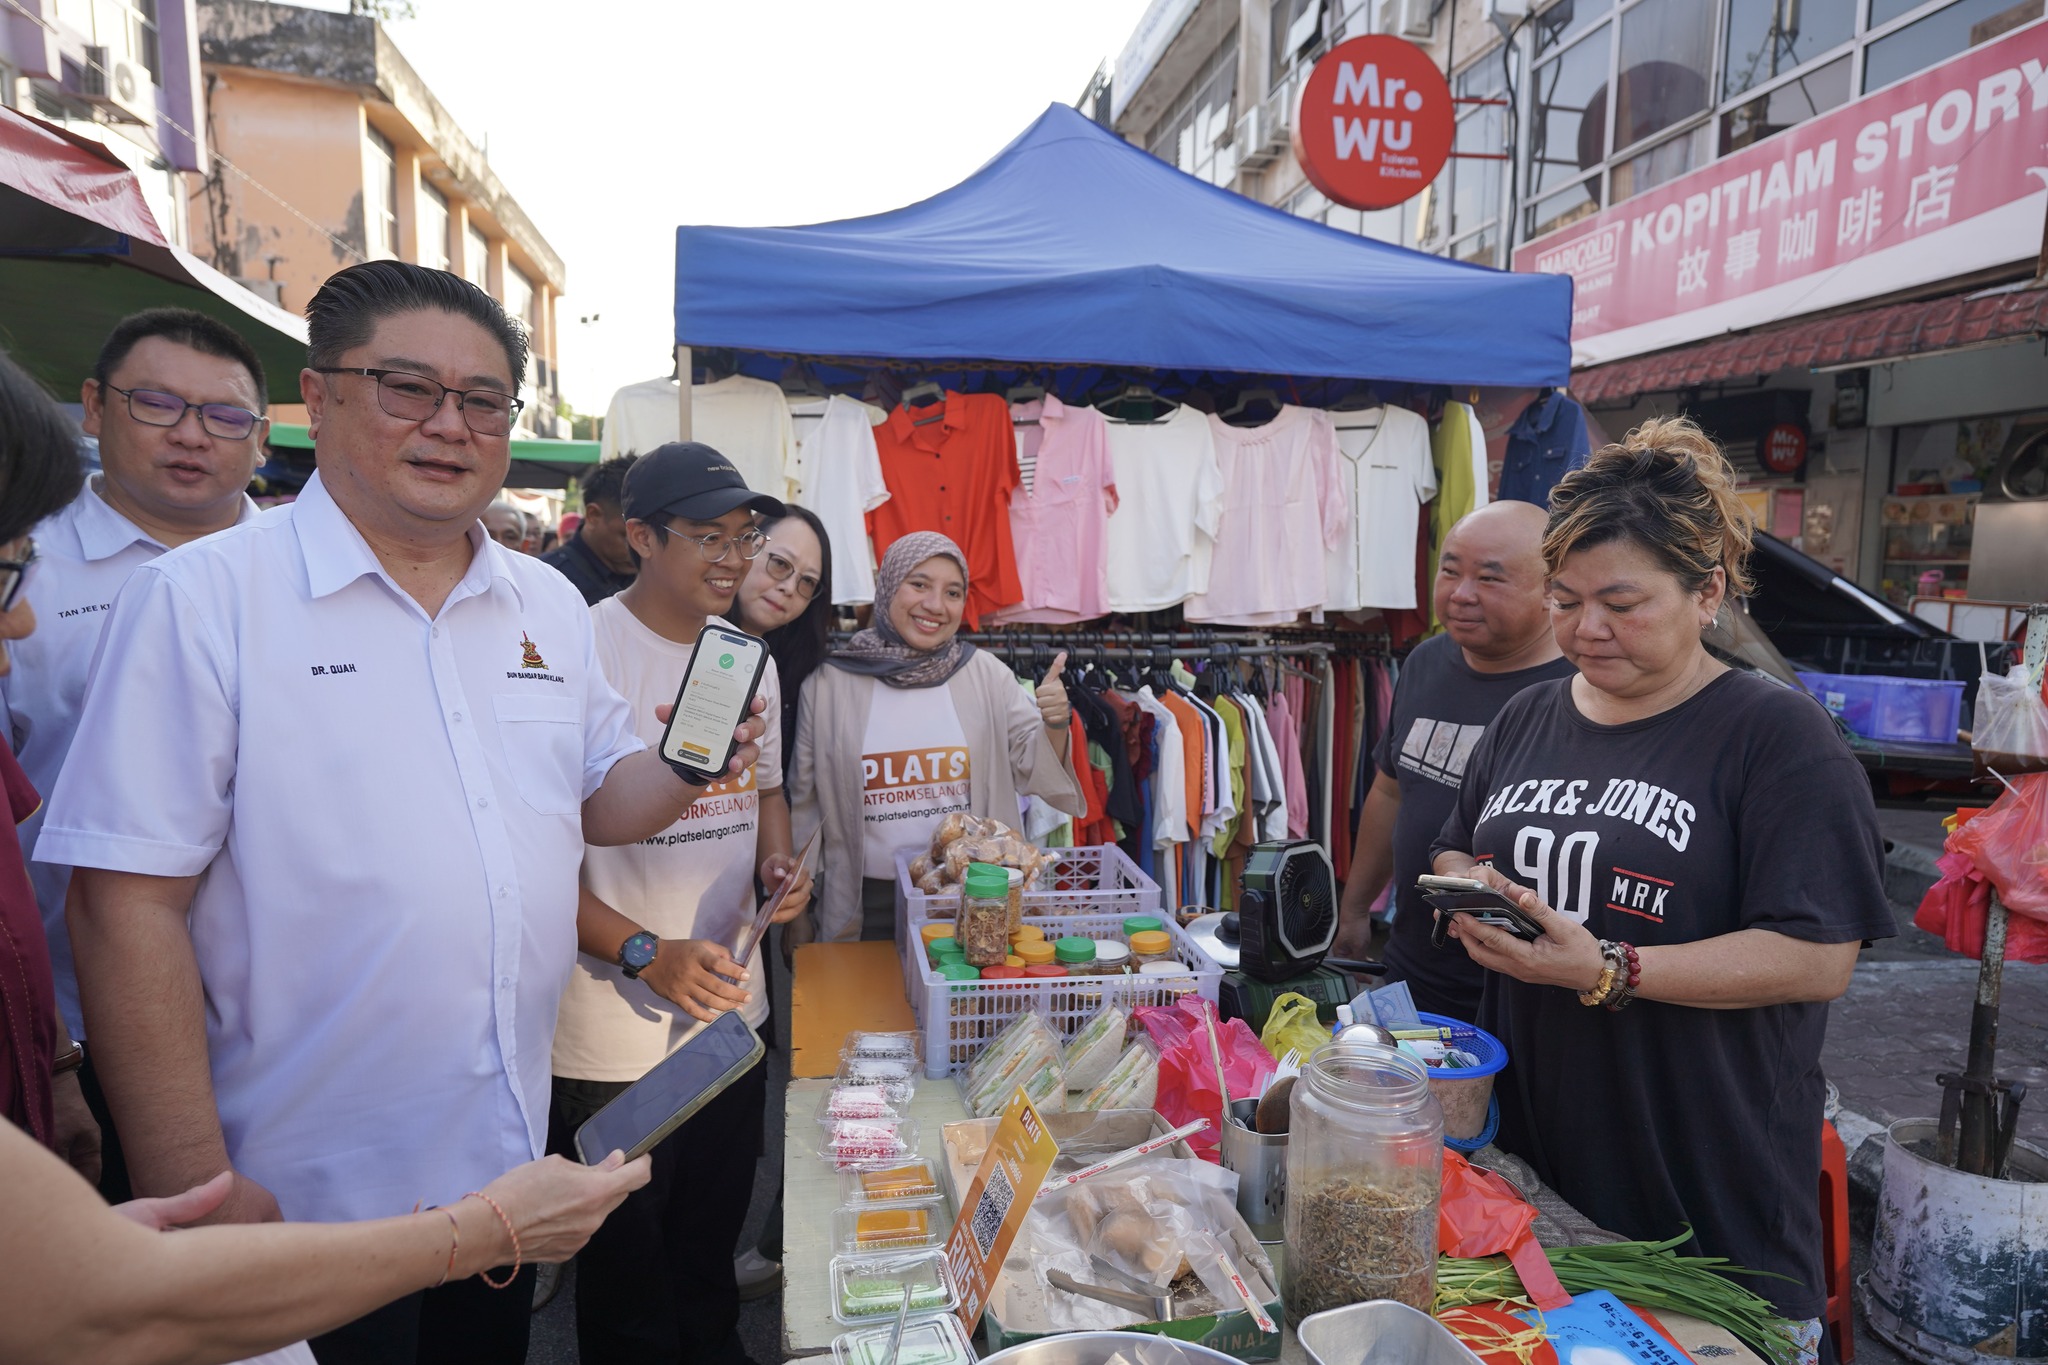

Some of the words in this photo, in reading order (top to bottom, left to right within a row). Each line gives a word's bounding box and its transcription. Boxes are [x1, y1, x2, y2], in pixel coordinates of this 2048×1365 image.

[1333, 61, 1423, 112] Mr.
[1379, 165, 1422, 179] Kitchen
[1381, 152, 1419, 166] Taiwan
[1631, 139, 1838, 256] KOPITIAM
[1675, 163, 1959, 297] 故事咖啡店
[1772, 430, 1799, 446] Mr.
[58, 608, 79, 618] TAN
[81, 605, 98, 614] JEE
[311, 665, 329, 676] DR.
[329, 663, 357, 674] QUAH
[518, 672, 537, 680] BANDAR
[537, 673, 550, 681] BARU
[862, 751, 967, 787] PLATS
[1586, 778, 1697, 853] JONES
[1513, 825, 1600, 925] 90
[1611, 876, 1670, 916] MRK
[1021, 1109, 1042, 1144] PLATS
[948, 1229, 975, 1300] RM5
